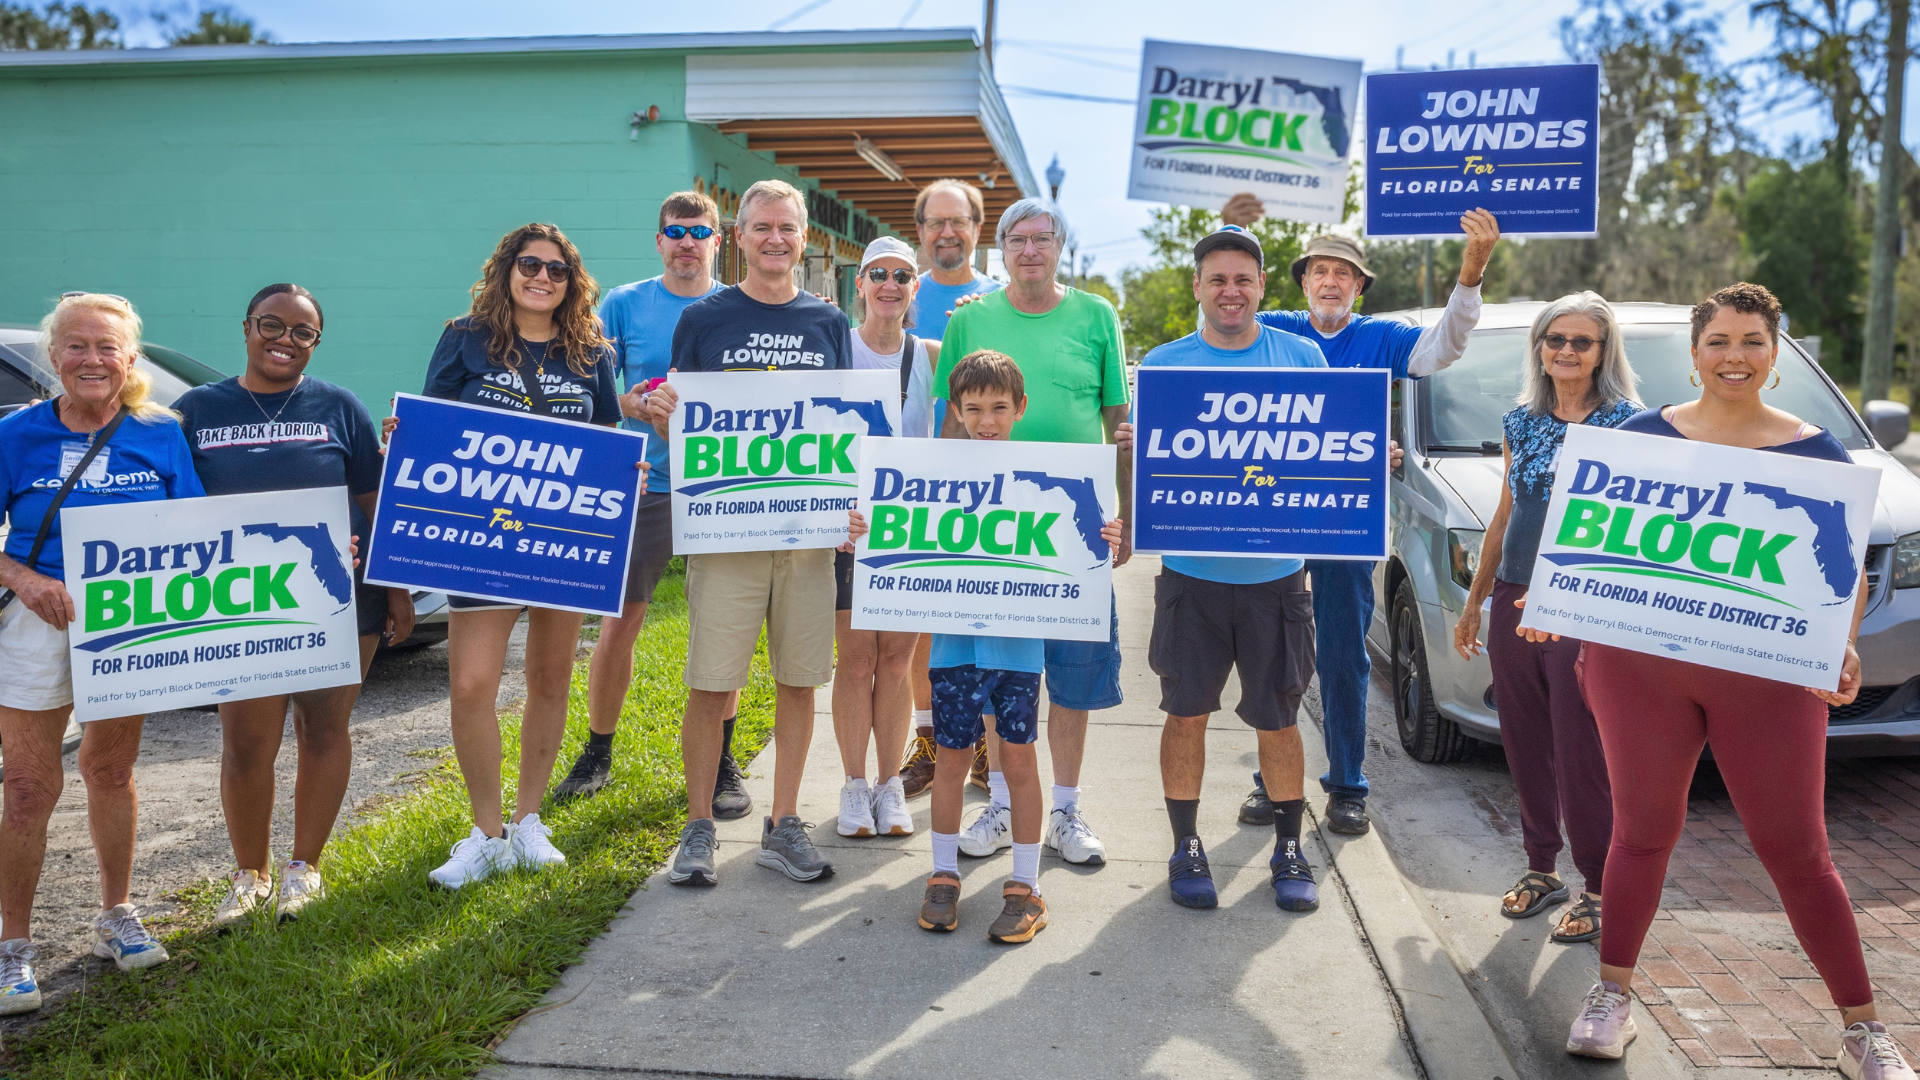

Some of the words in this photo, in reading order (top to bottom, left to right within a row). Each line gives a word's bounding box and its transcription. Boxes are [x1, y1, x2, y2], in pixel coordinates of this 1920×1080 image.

[1150, 66, 1264, 110] Darryl
[1422, 87, 1540, 119] JOHN
[1145, 97, 1309, 152] BLOCK
[1376, 119, 1588, 153] LOWNDES
[1463, 156, 1495, 175] For
[1380, 179, 1479, 194] FLORIDA
[1490, 176, 1582, 192] SENATE
[746, 333, 803, 349] JOHN
[722, 349, 824, 367] LOWNDES
[483, 370, 583, 395] LOWDES
[477, 390, 531, 412] FLORIDA
[1197, 393, 1325, 423] JOHN
[198, 427, 228, 445] TAKE
[231, 424, 266, 440] BACK
[270, 423, 322, 438] FLORIDA
[682, 401, 804, 439] Darryl
[453, 430, 583, 476] JOHN
[684, 433, 856, 479] BLOCK
[1146, 429, 1376, 462] LOWNDES
[394, 458, 626, 519] LOWNDES
[870, 467, 1004, 513] Darryl
[1242, 465, 1277, 487] For
[1567, 458, 1734, 521] Darryl
[687, 501, 712, 516] FOR
[715, 500, 765, 515] FLORIDA
[768, 498, 807, 513] HOUSE
[809, 496, 858, 511] DISTRICT
[1150, 489, 1259, 506] FLORIDA
[1271, 492, 1370, 508] SENATE
[489, 508, 524, 532] For
[713, 531, 722, 540] by
[723, 530, 746, 539] Darryl
[747, 529, 768, 537] Block
[768, 528, 804, 536] Democrat
[816, 526, 841, 534] Florida
[868, 505, 1061, 557] BLOCK
[81, 530, 234, 579] Darryl
[390, 519, 503, 549] FLORIDA
[515, 538, 612, 565] SENATE
[1555, 498, 1798, 586] BLOCK
[423, 560, 453, 569] approved
[540, 576, 560, 584] Florida
[559, 578, 580, 587] Senate
[579, 581, 599, 590] District
[868, 574, 895, 590] FOR
[898, 575, 952, 593] FLORIDA
[955, 578, 1000, 595] HOUSE
[1001, 580, 1060, 598] DISTRICT
[1060, 582, 1080, 599] 36
[85, 562, 299, 633] BLOCK
[1548, 571, 1581, 592] FOR
[1582, 577, 1648, 606] FLORIDA
[1650, 590, 1707, 617] HOUSE
[1707, 601, 1782, 631] DISTRICT
[1781, 616, 1808, 636] 36
[862, 606, 880, 615] Paid
[880, 607, 893, 615] for
[893, 608, 904, 618] by
[905, 608, 930, 619] Darryl
[930, 609, 953, 618] Block
[954, 610, 993, 620] Democrat
[994, 612, 1006, 620] for
[1007, 613, 1035, 622] Florida
[1036, 614, 1058, 623] State
[1059, 615, 1089, 625] District
[1090, 617, 1101, 626] 36
[91, 657, 122, 676] FOR
[126, 649, 189, 672] FLORIDA
[193, 642, 241, 663] HOUSE
[244, 634, 305, 656] DISTRICT
[306, 630, 326, 648] 36
[1536, 604, 1557, 616] Paid
[1558, 608, 1572, 618] for
[1572, 612, 1585, 623] by
[1586, 614, 1616, 629] Darryl
[1617, 620, 1643, 633] Block
[1644, 626, 1692, 644] Democrat
[1694, 636, 1709, 646] for
[1710, 639, 1744, 654] Florida
[1746, 647, 1774, 660] State
[1775, 652, 1813, 668] District
[1814, 660, 1829, 671] 36
[87, 693, 108, 704] Paid
[109, 692, 123, 701] for
[125, 690, 137, 700] by
[138, 685, 167, 697] Darryl
[168, 682, 193, 693] Block
[194, 677, 238, 689] Democrat
[238, 674, 252, 683] for
[253, 670, 283, 681] Florida
[284, 668, 307, 677] State
[308, 663, 338, 674] District
[340, 660, 351, 670] 36
